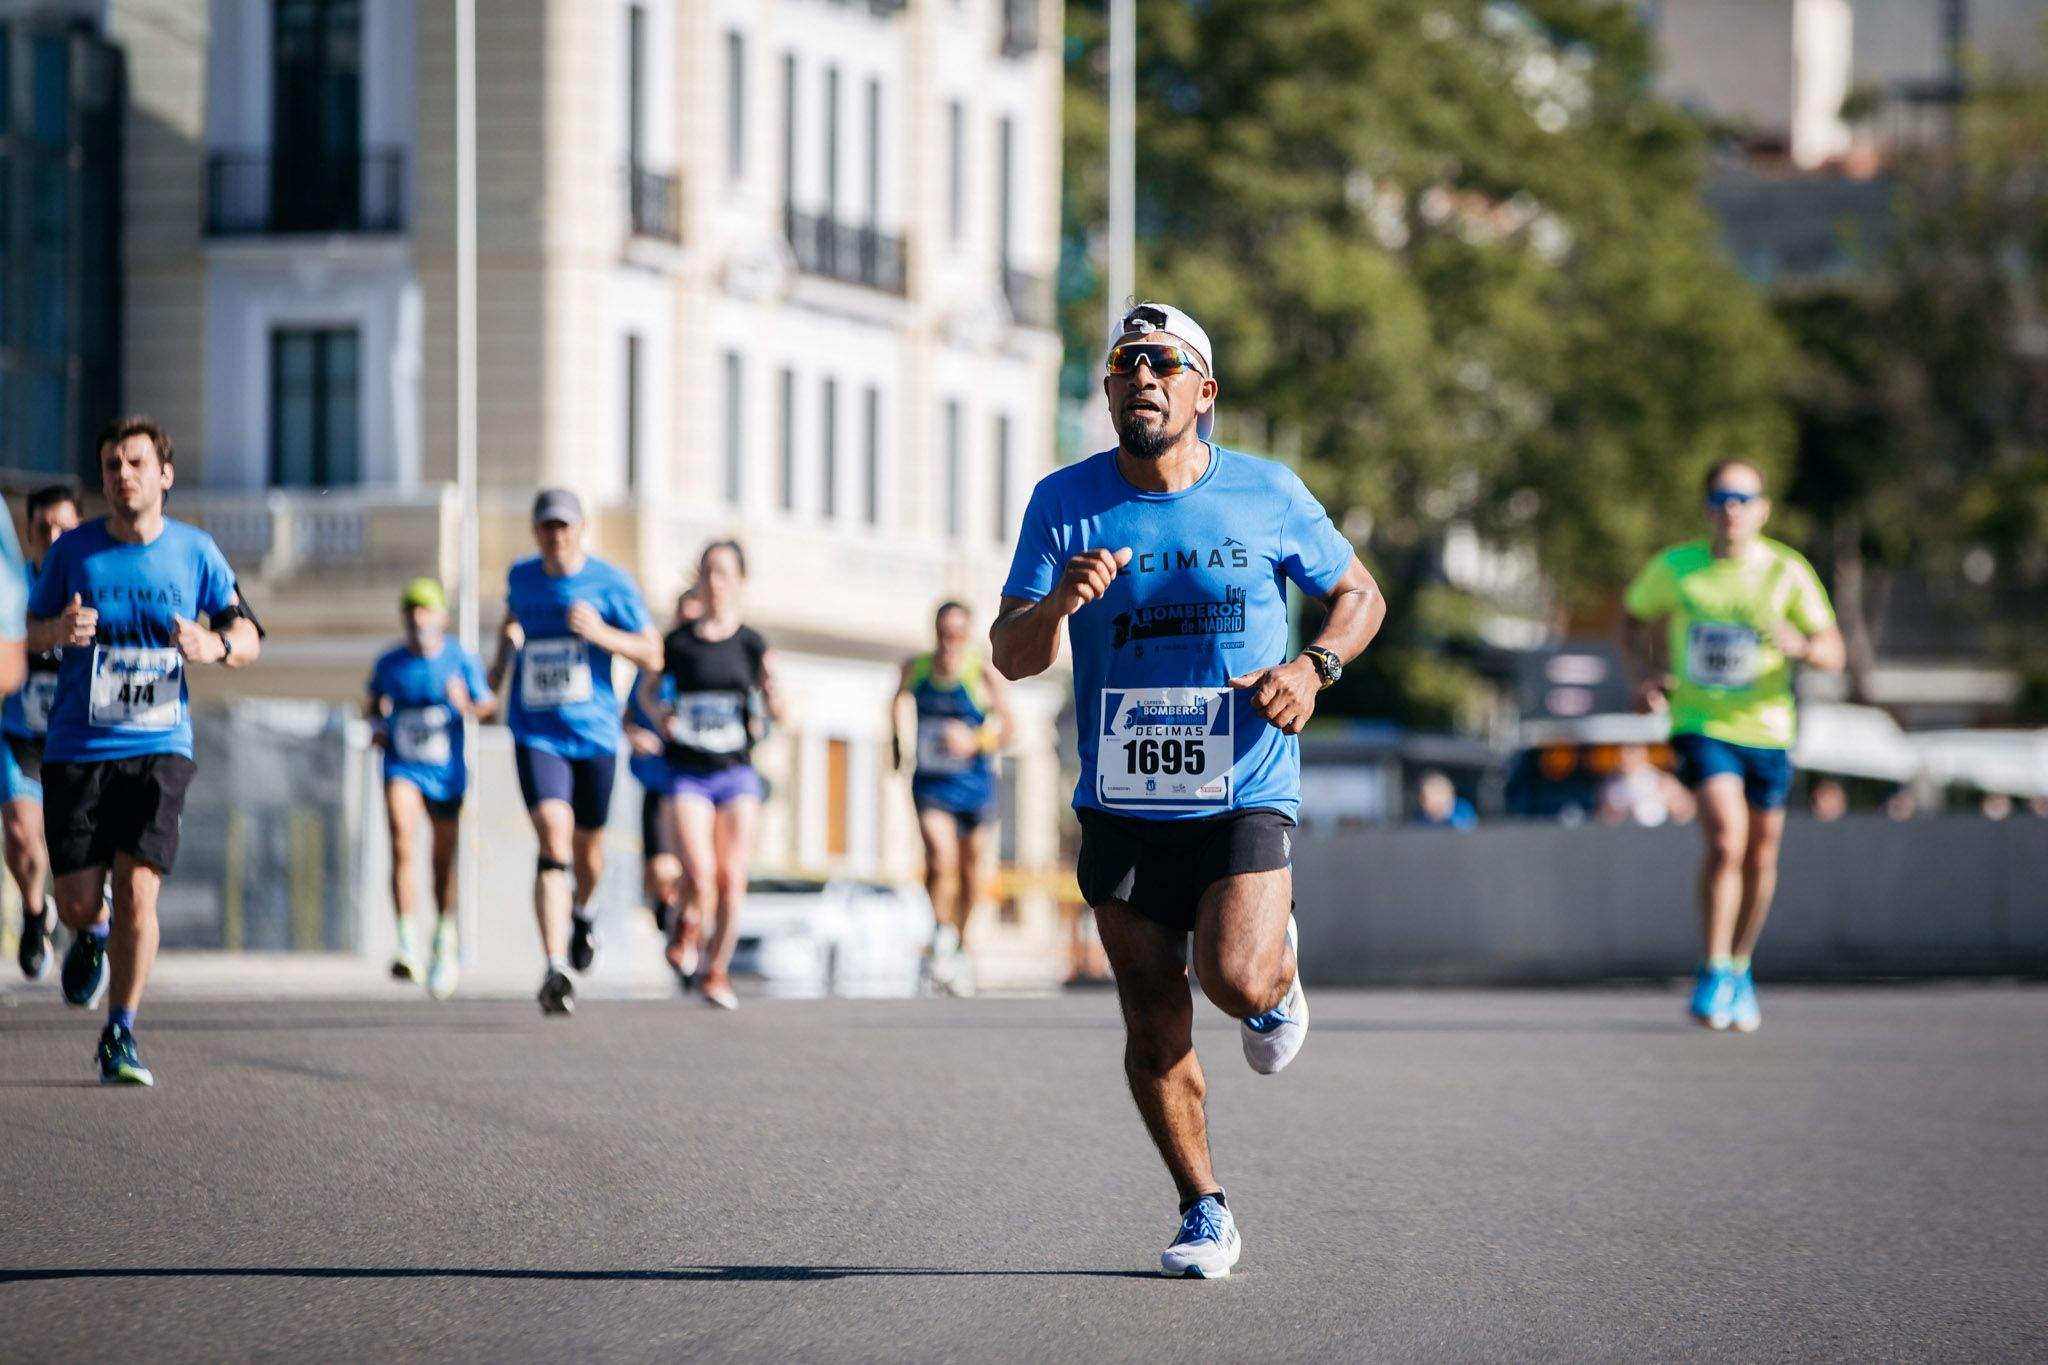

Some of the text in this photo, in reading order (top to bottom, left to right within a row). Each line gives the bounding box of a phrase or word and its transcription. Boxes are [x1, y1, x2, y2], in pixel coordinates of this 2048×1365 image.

[1117, 549, 1248, 576] CIMAS
[1143, 603, 1242, 620] BOMBEROS
[1198, 617, 1242, 633] MADRID
[1143, 706, 1205, 716] BOMBEROS
[1136, 726, 1203, 736] DECIMAS
[1123, 739, 1205, 775] 1695
